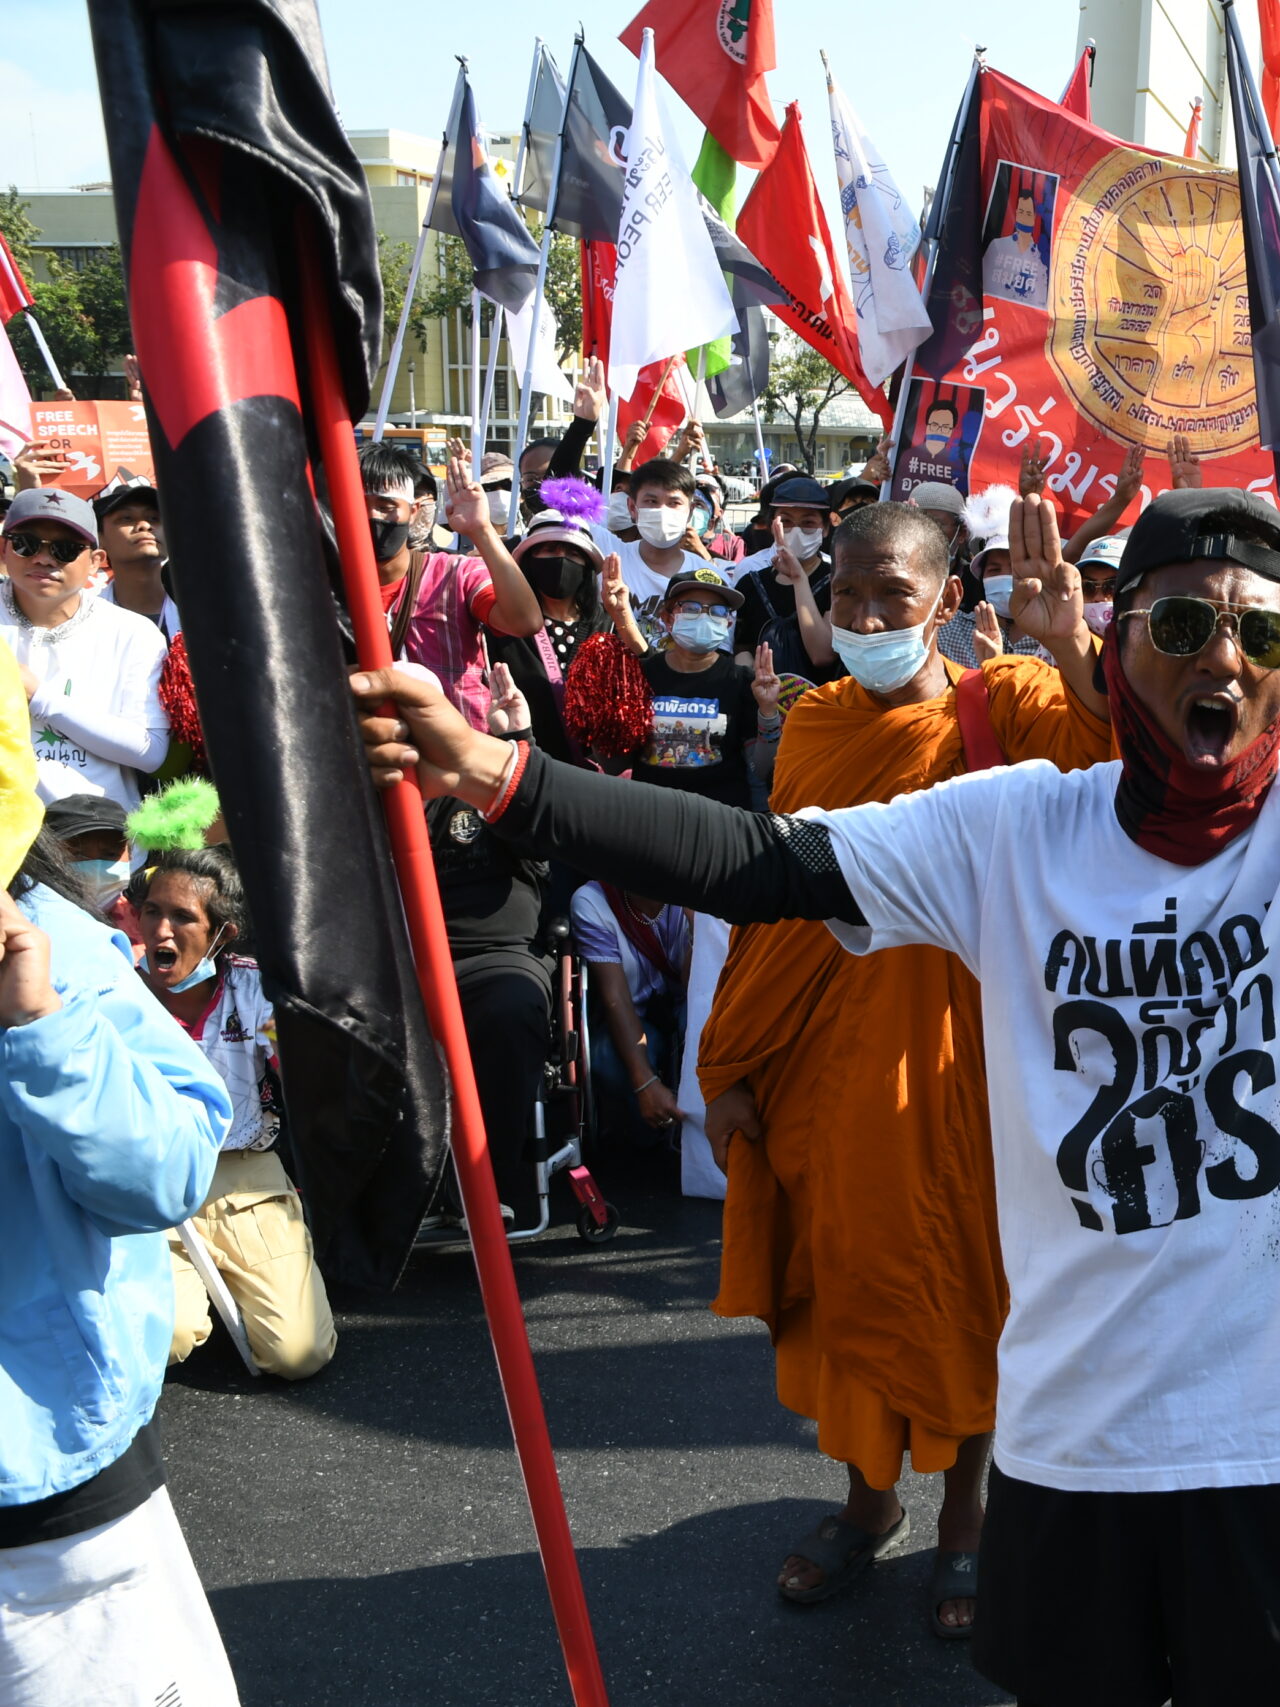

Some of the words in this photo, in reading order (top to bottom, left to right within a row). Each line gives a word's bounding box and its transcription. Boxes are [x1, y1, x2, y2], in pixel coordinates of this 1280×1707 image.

[996, 254, 1039, 275] #FREE
[35, 410, 75, 423] FREE
[38, 424, 98, 437] SPEECH
[49, 438, 72, 449] OR
[909, 457, 953, 479] #FREE
[652, 698, 716, 716] ตพิสดาร
